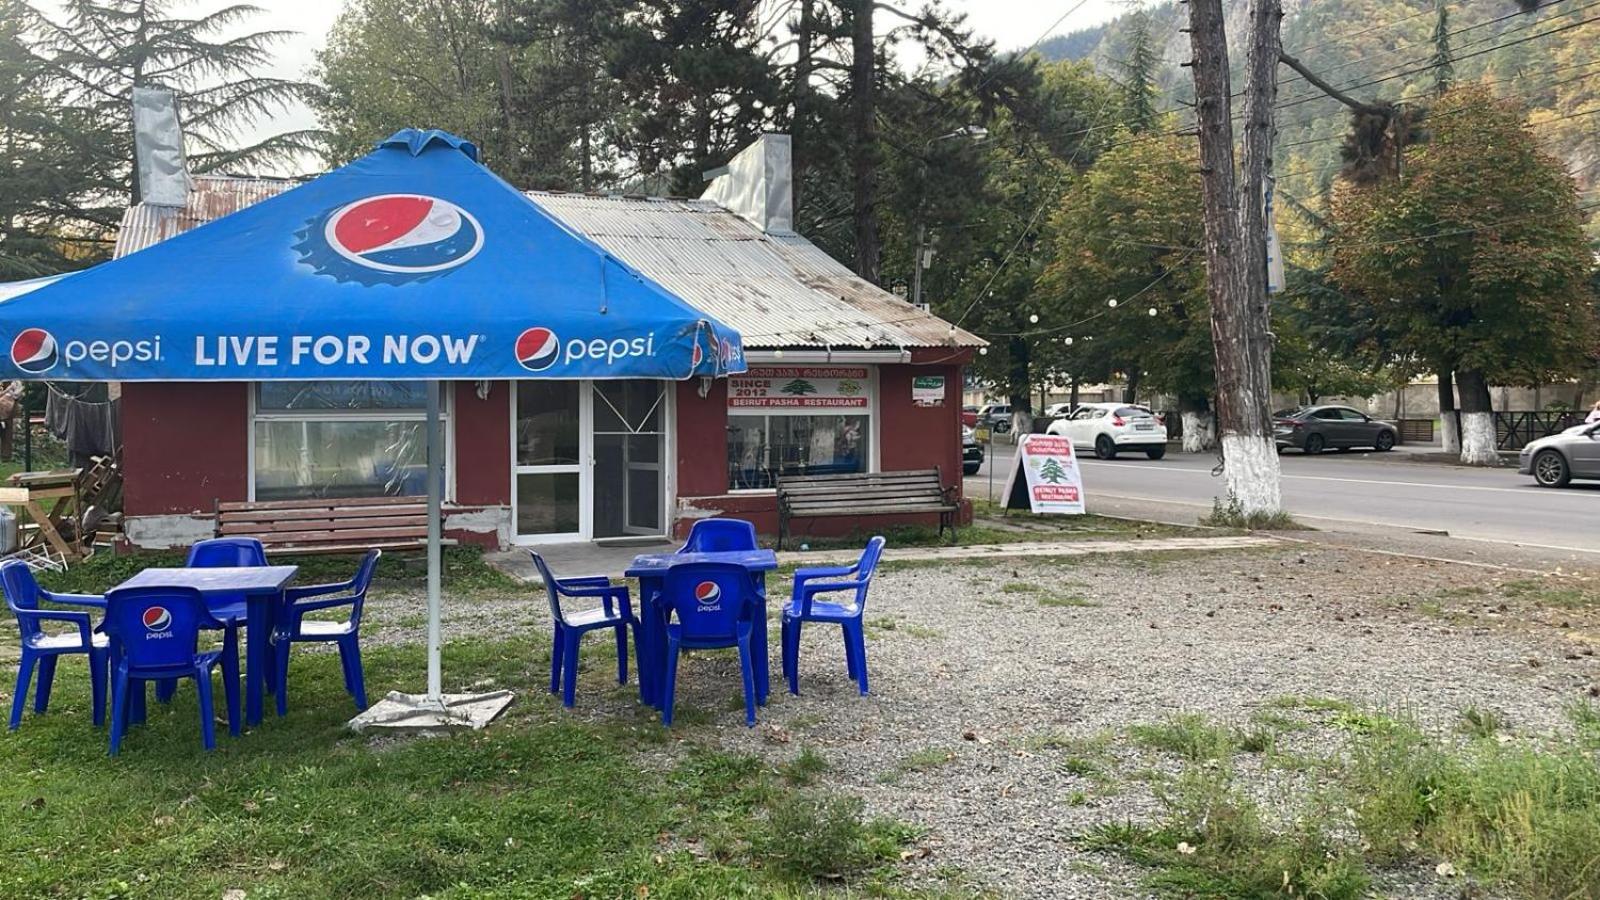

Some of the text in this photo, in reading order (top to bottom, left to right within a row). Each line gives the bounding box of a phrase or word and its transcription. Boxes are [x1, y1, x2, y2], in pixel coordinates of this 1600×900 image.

[65, 335, 163, 367] pepsi
[195, 336, 278, 366] LIVE
[291, 335, 371, 365] FOR
[564, 332, 655, 365] pepsi
[731, 380, 771, 388] SINCE
[736, 388, 767, 397] 2012
